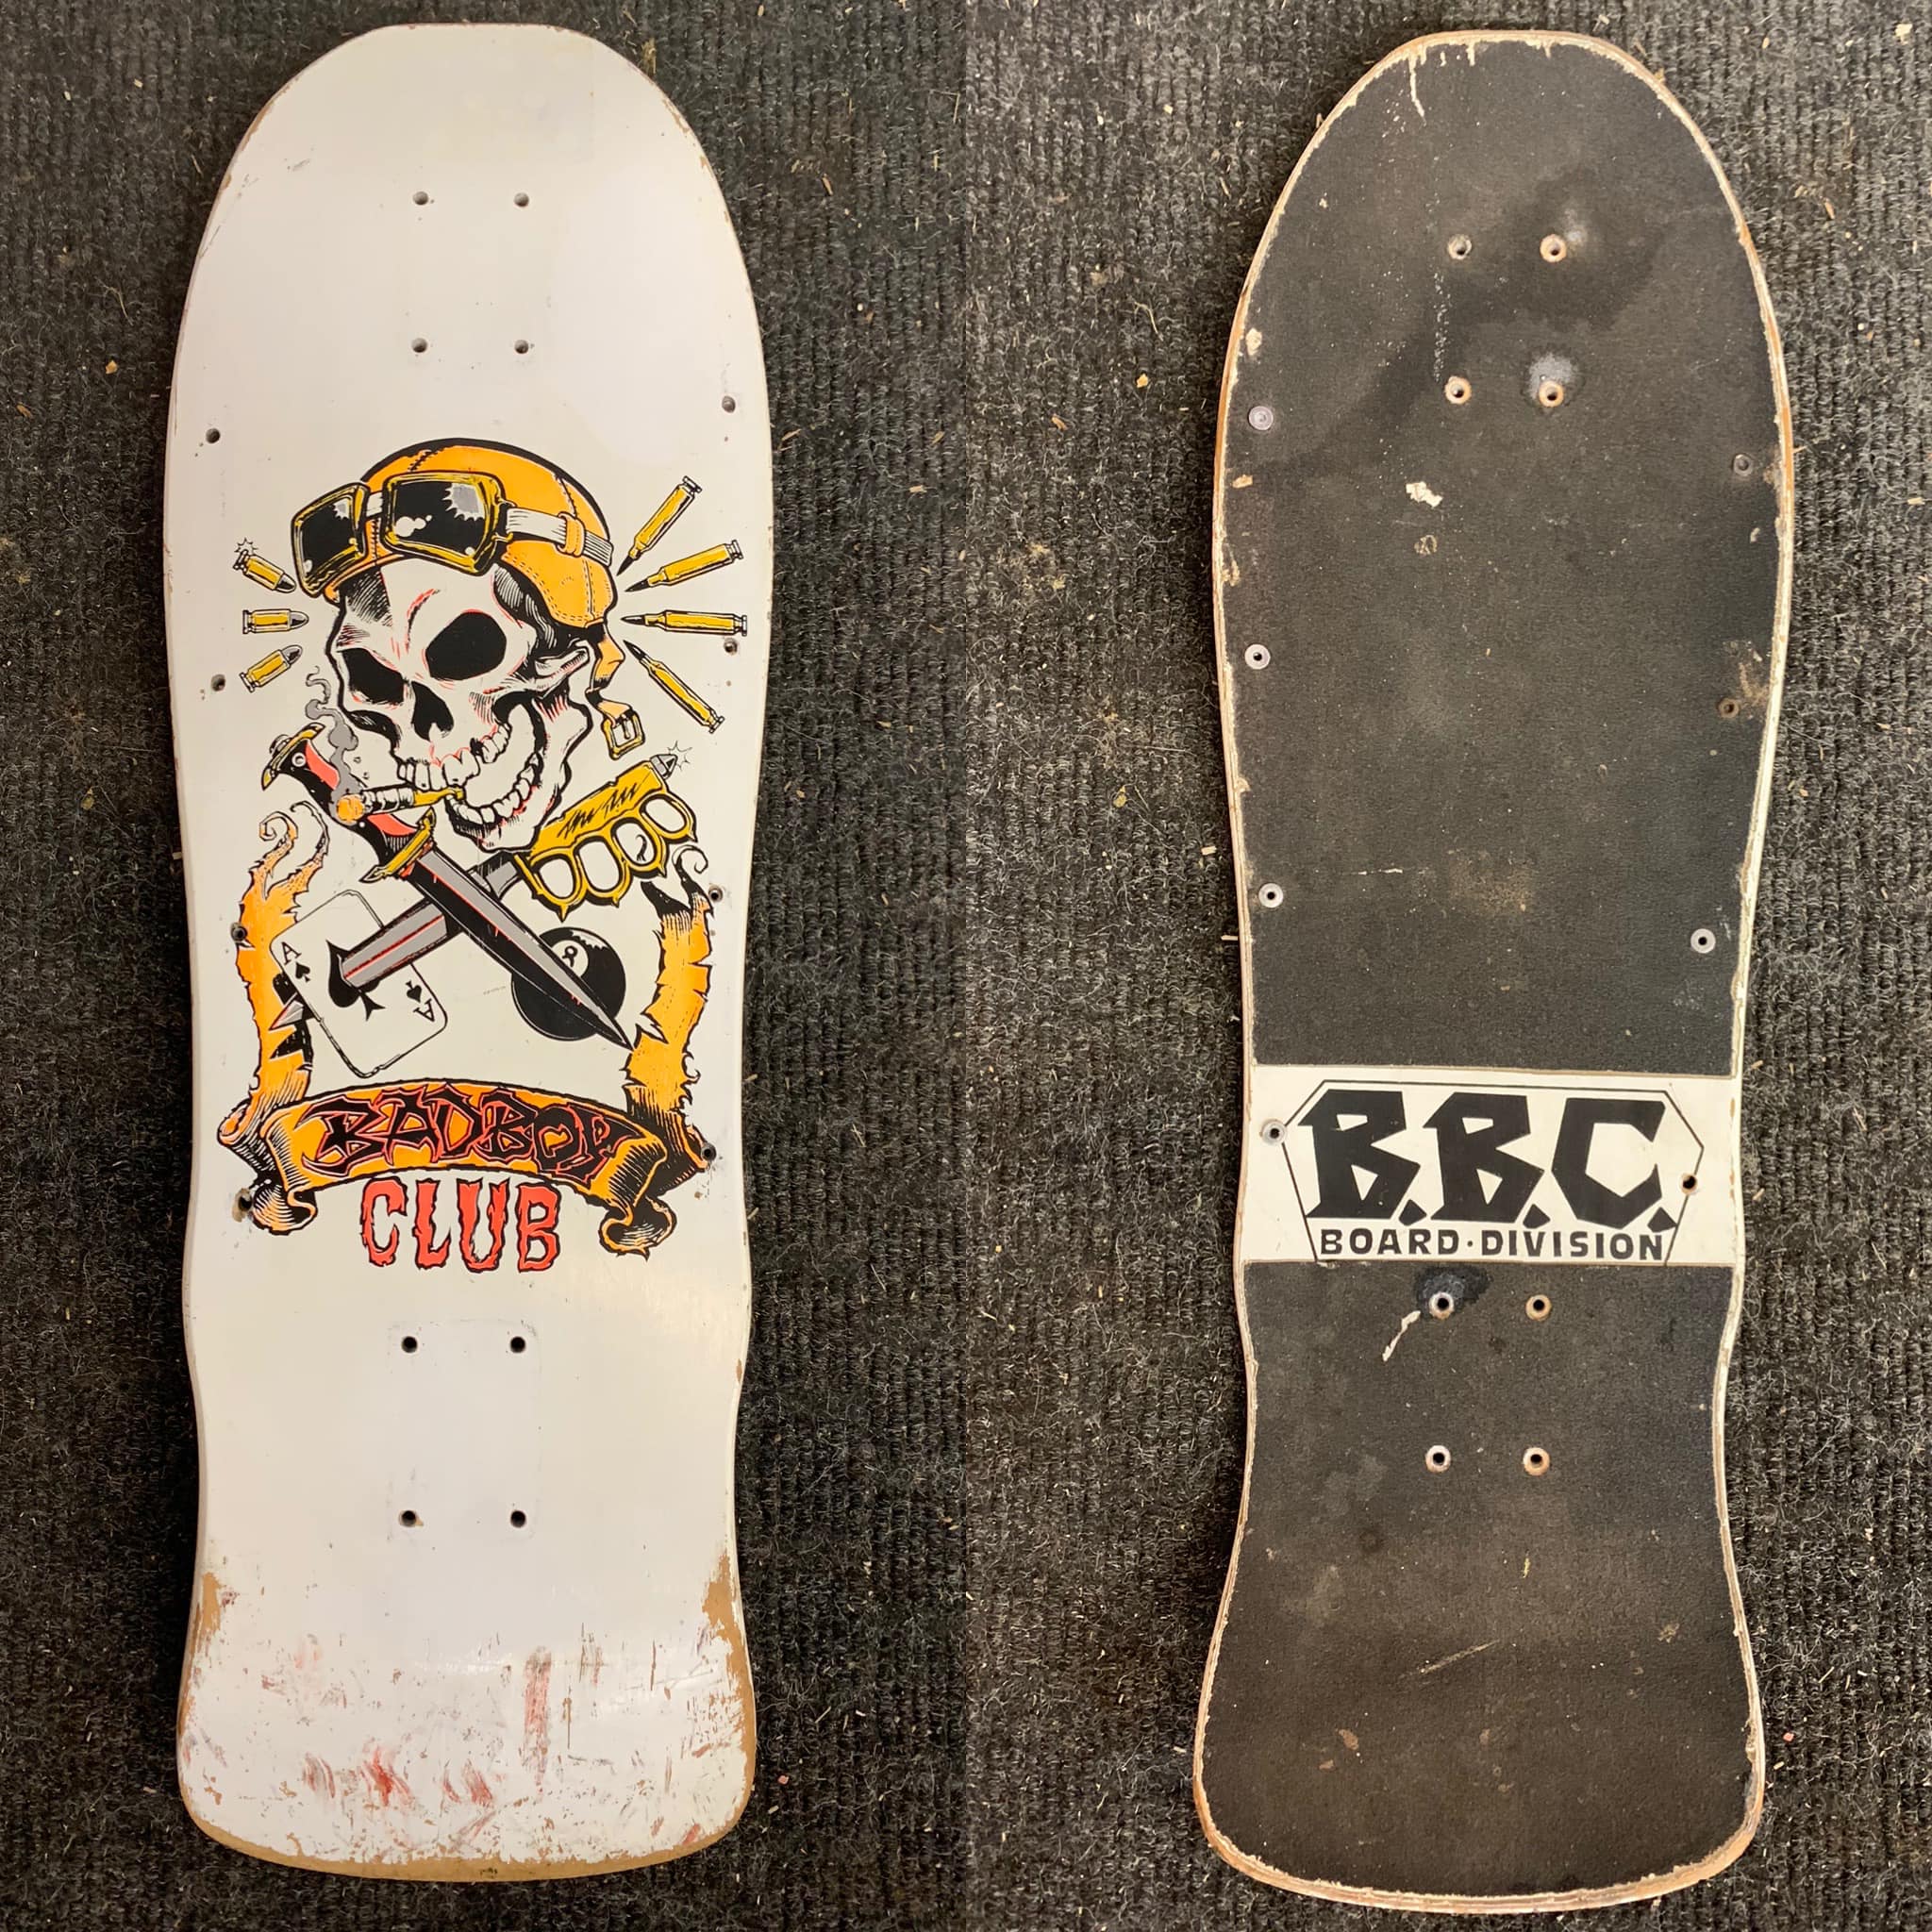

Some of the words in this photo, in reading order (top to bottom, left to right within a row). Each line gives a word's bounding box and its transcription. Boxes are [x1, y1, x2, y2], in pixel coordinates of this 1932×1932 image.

[281, 941, 302, 964] A
[412, 998, 435, 1023] A
[1297, 1089, 1678, 1230] B.B.C.
[360, 1176, 560, 1273] CLUB
